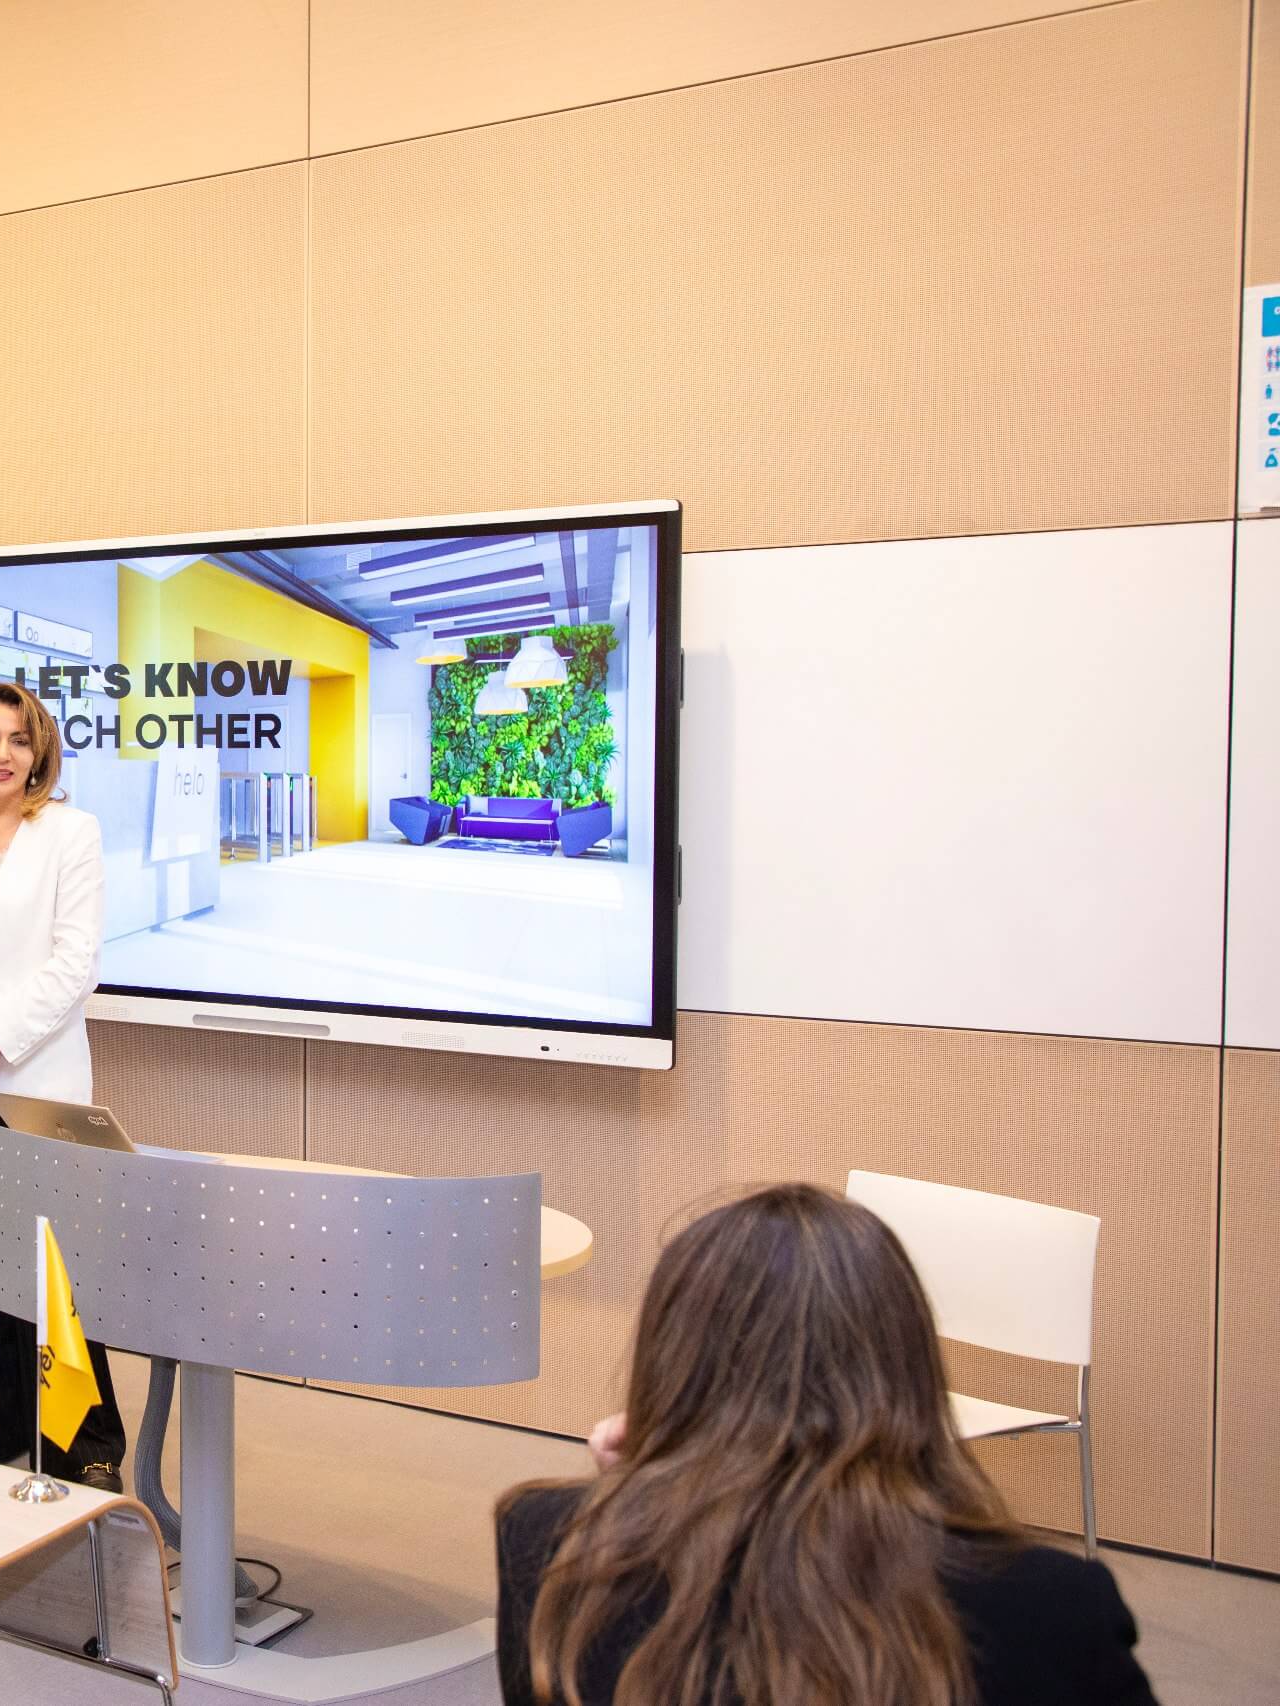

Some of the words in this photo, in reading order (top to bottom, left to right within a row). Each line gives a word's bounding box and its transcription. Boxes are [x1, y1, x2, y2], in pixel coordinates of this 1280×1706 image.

[144, 659, 292, 698] KNOW
[51, 713, 120, 749] CH
[135, 713, 282, 750] OTHER
